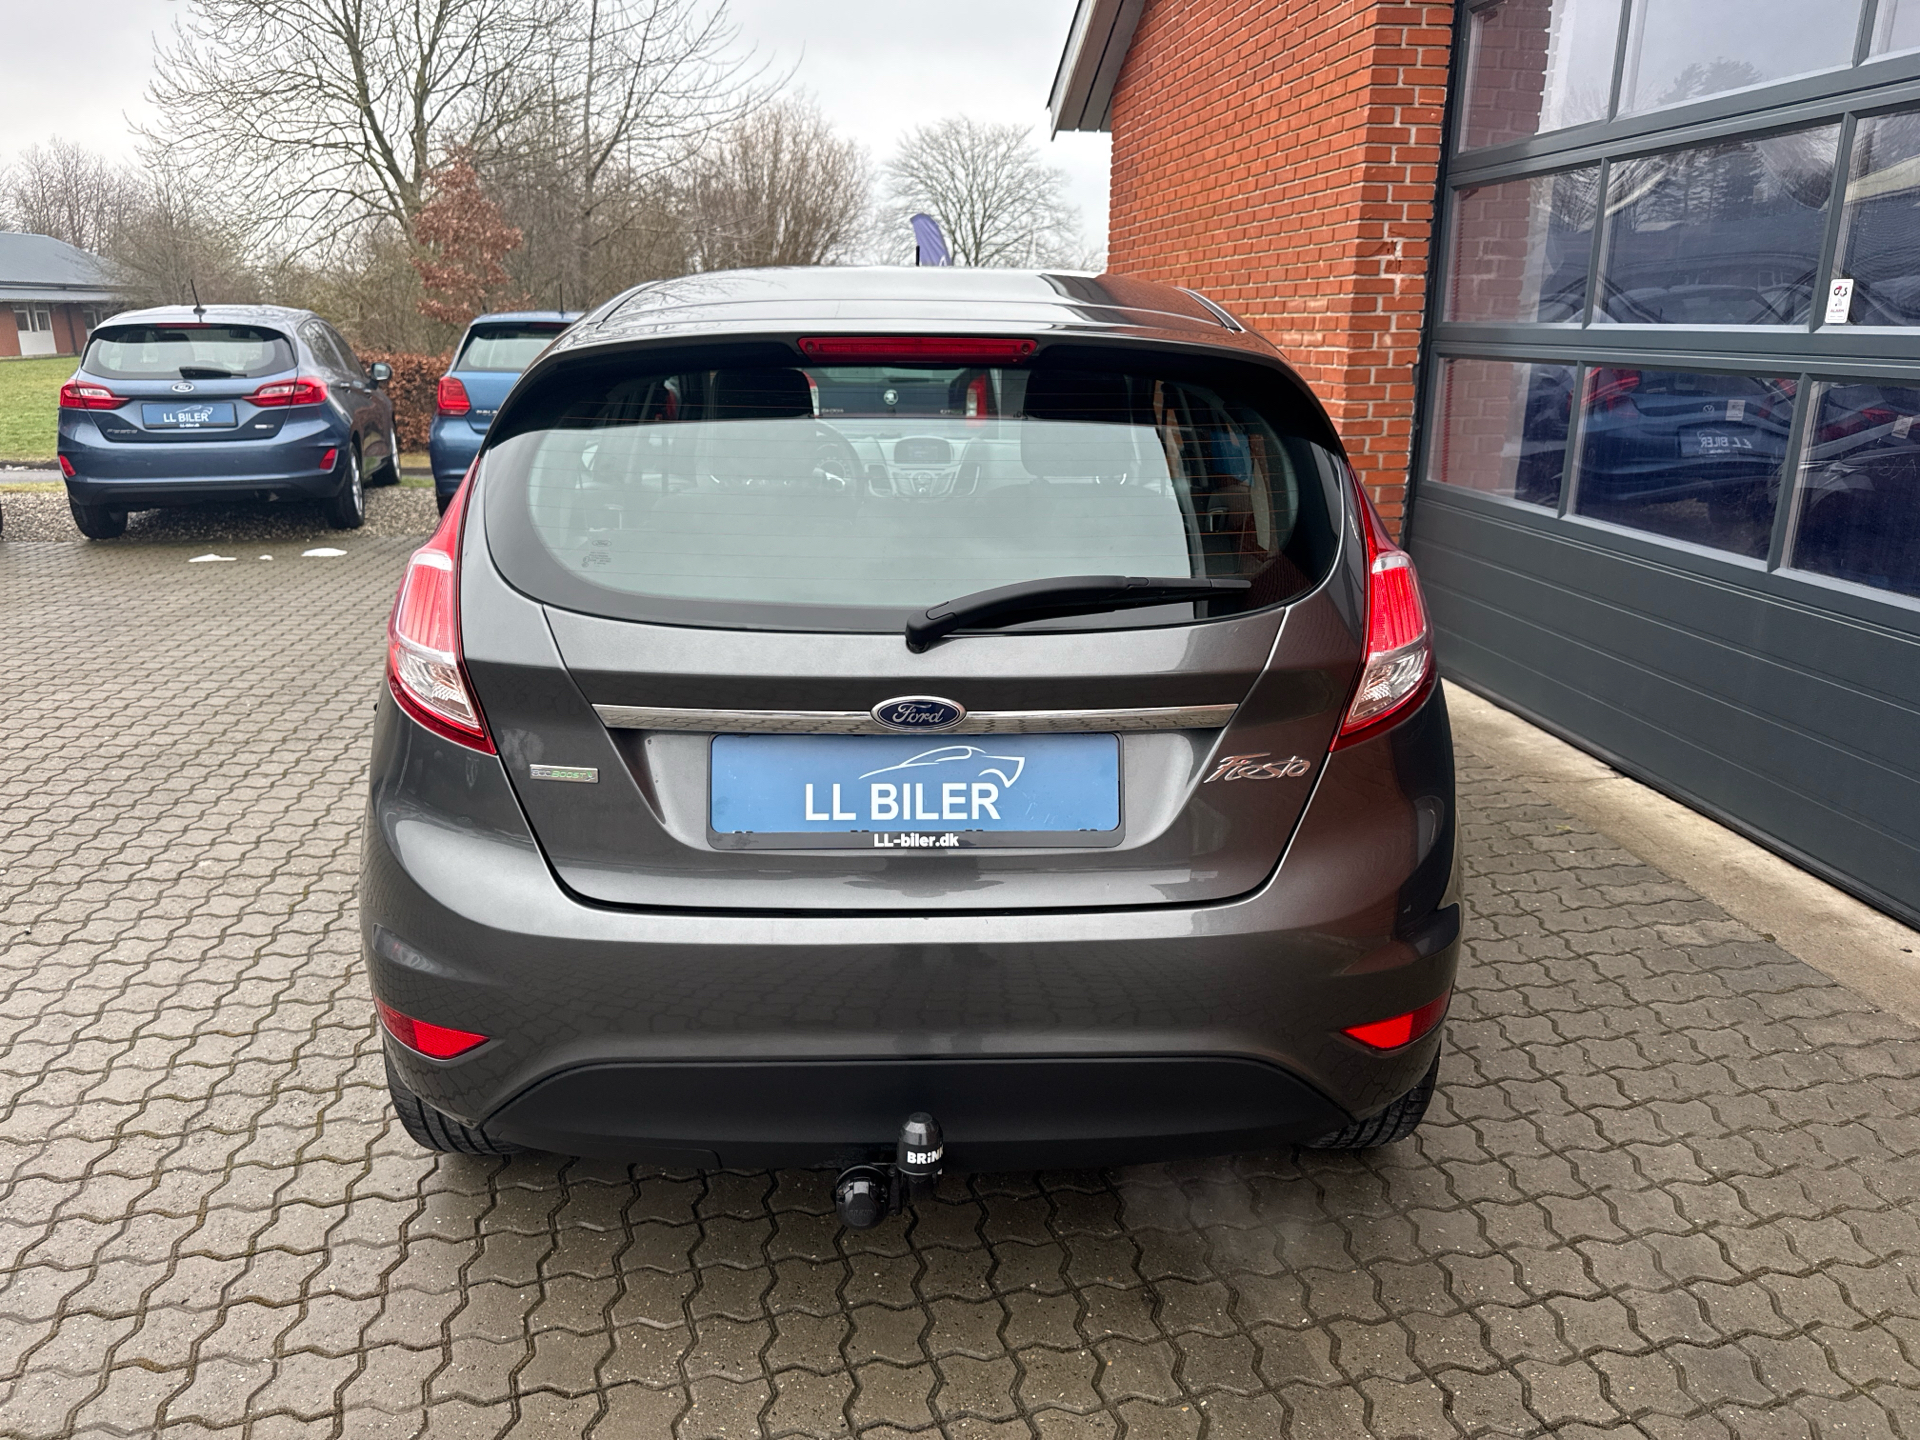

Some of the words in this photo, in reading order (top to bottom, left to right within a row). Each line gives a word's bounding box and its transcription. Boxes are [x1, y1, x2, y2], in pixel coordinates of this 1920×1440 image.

[163, 412, 177, 423] LL
[178, 412, 209, 422] BILER
[892, 703, 945, 723] Ford
[1203, 752, 1311, 784] Fiesta
[805, 783, 857, 821] LL
[870, 782, 1002, 821] BILER
[873, 832, 960, 848] LL-biler.dk
